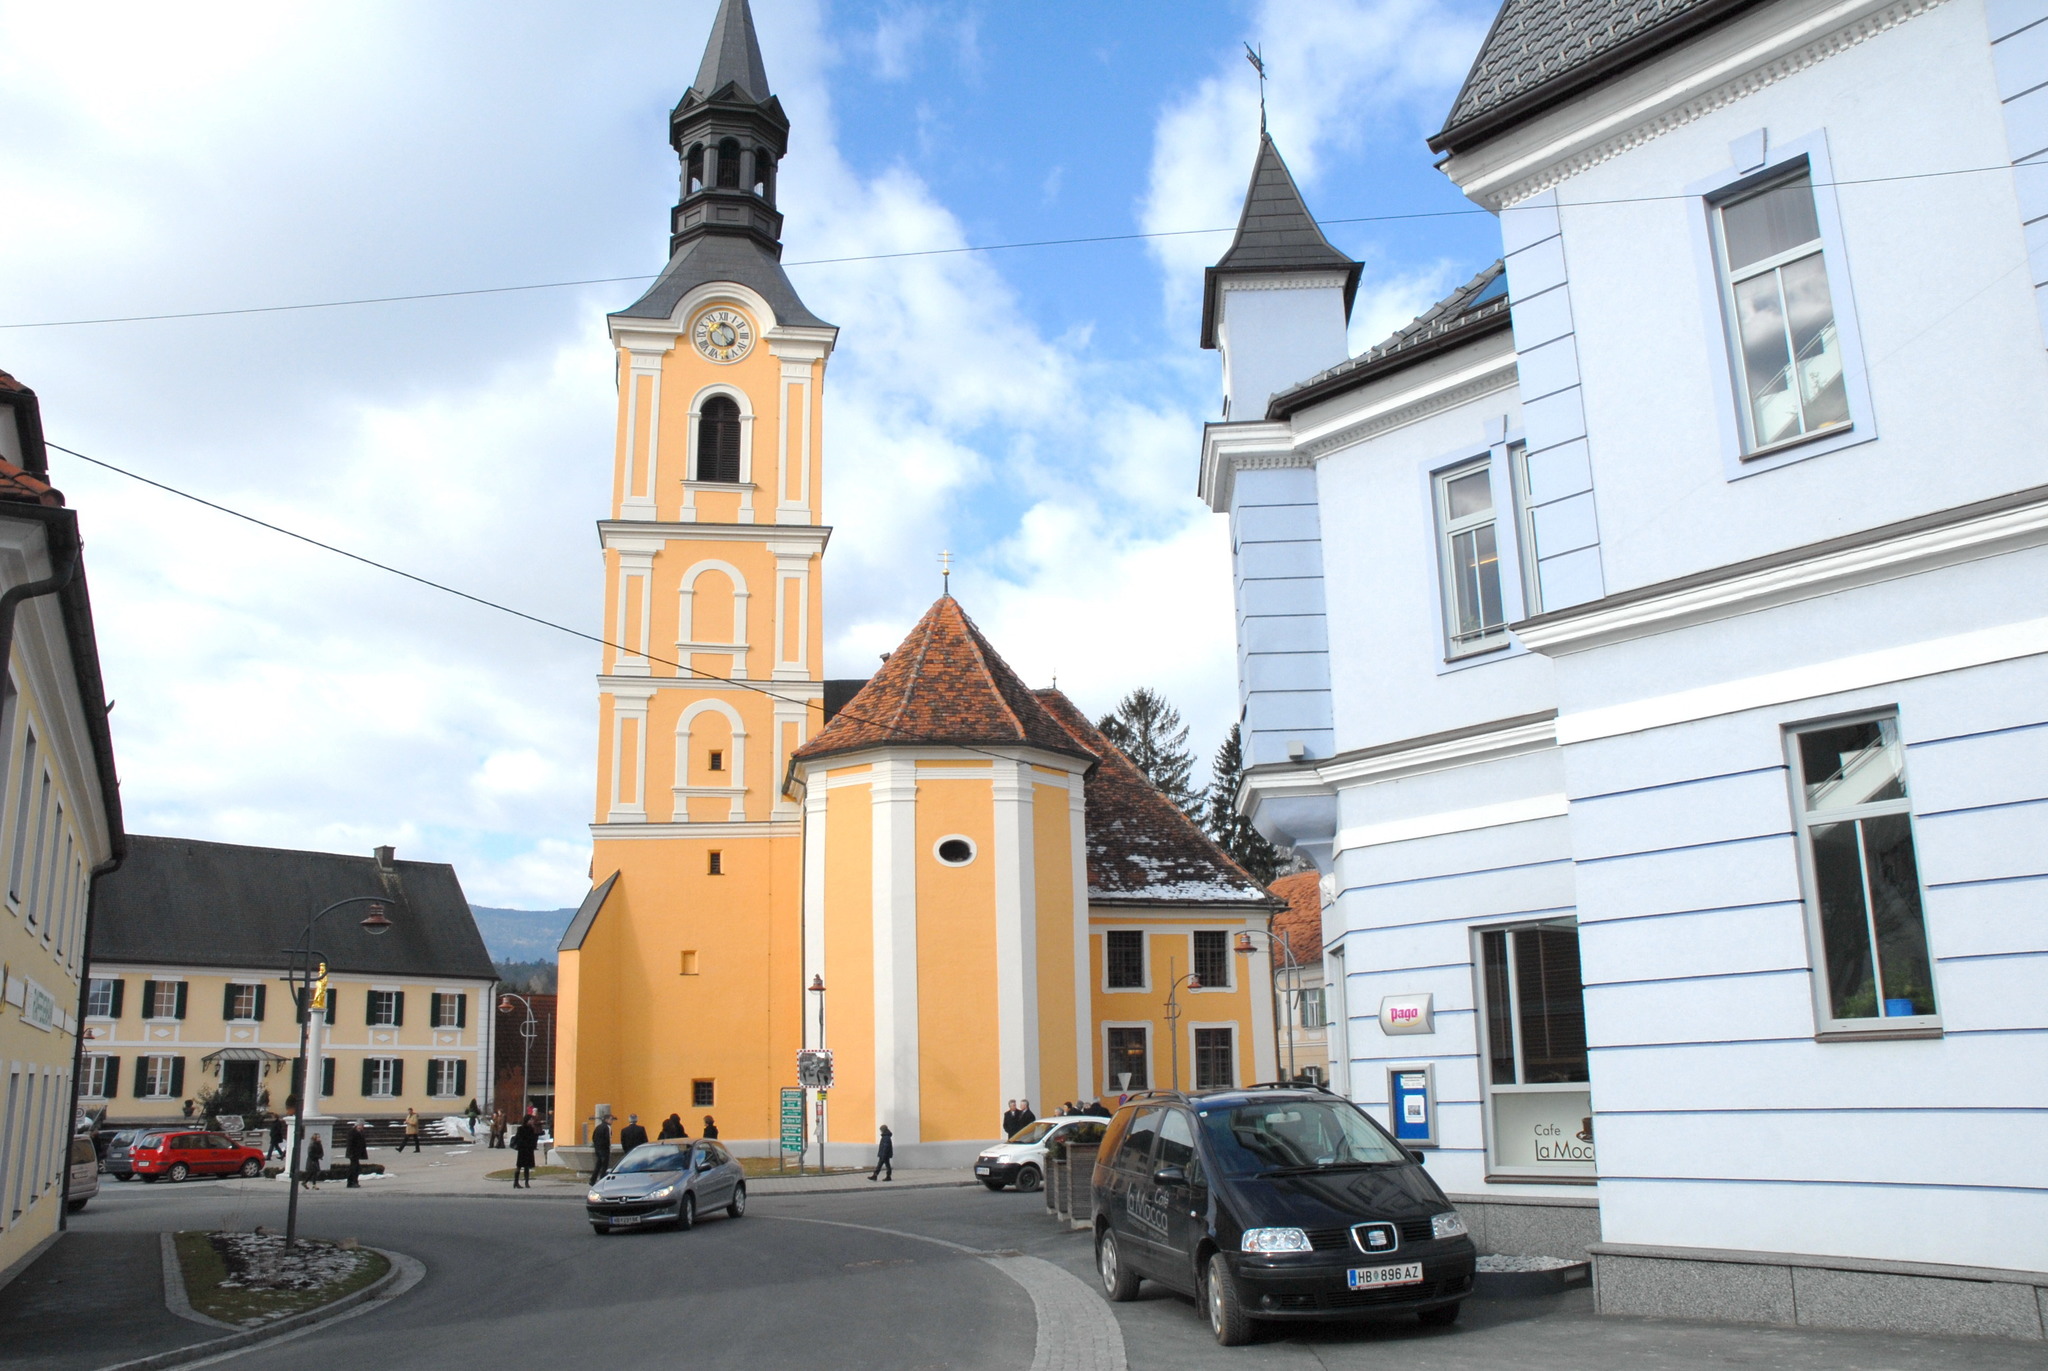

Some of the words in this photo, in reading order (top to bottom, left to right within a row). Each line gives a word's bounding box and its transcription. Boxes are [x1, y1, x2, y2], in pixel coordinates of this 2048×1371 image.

[1390, 1007, 1418, 1023] pago
[1534, 1123, 1561, 1136] Cafe
[1554, 1140, 1595, 1159] Moc
[1135, 1190, 1168, 1231] Mocca
[1358, 1270, 1372, 1283] HB
[1381, 1268, 1402, 1281] 896
[1404, 1266, 1419, 1279] AZ
